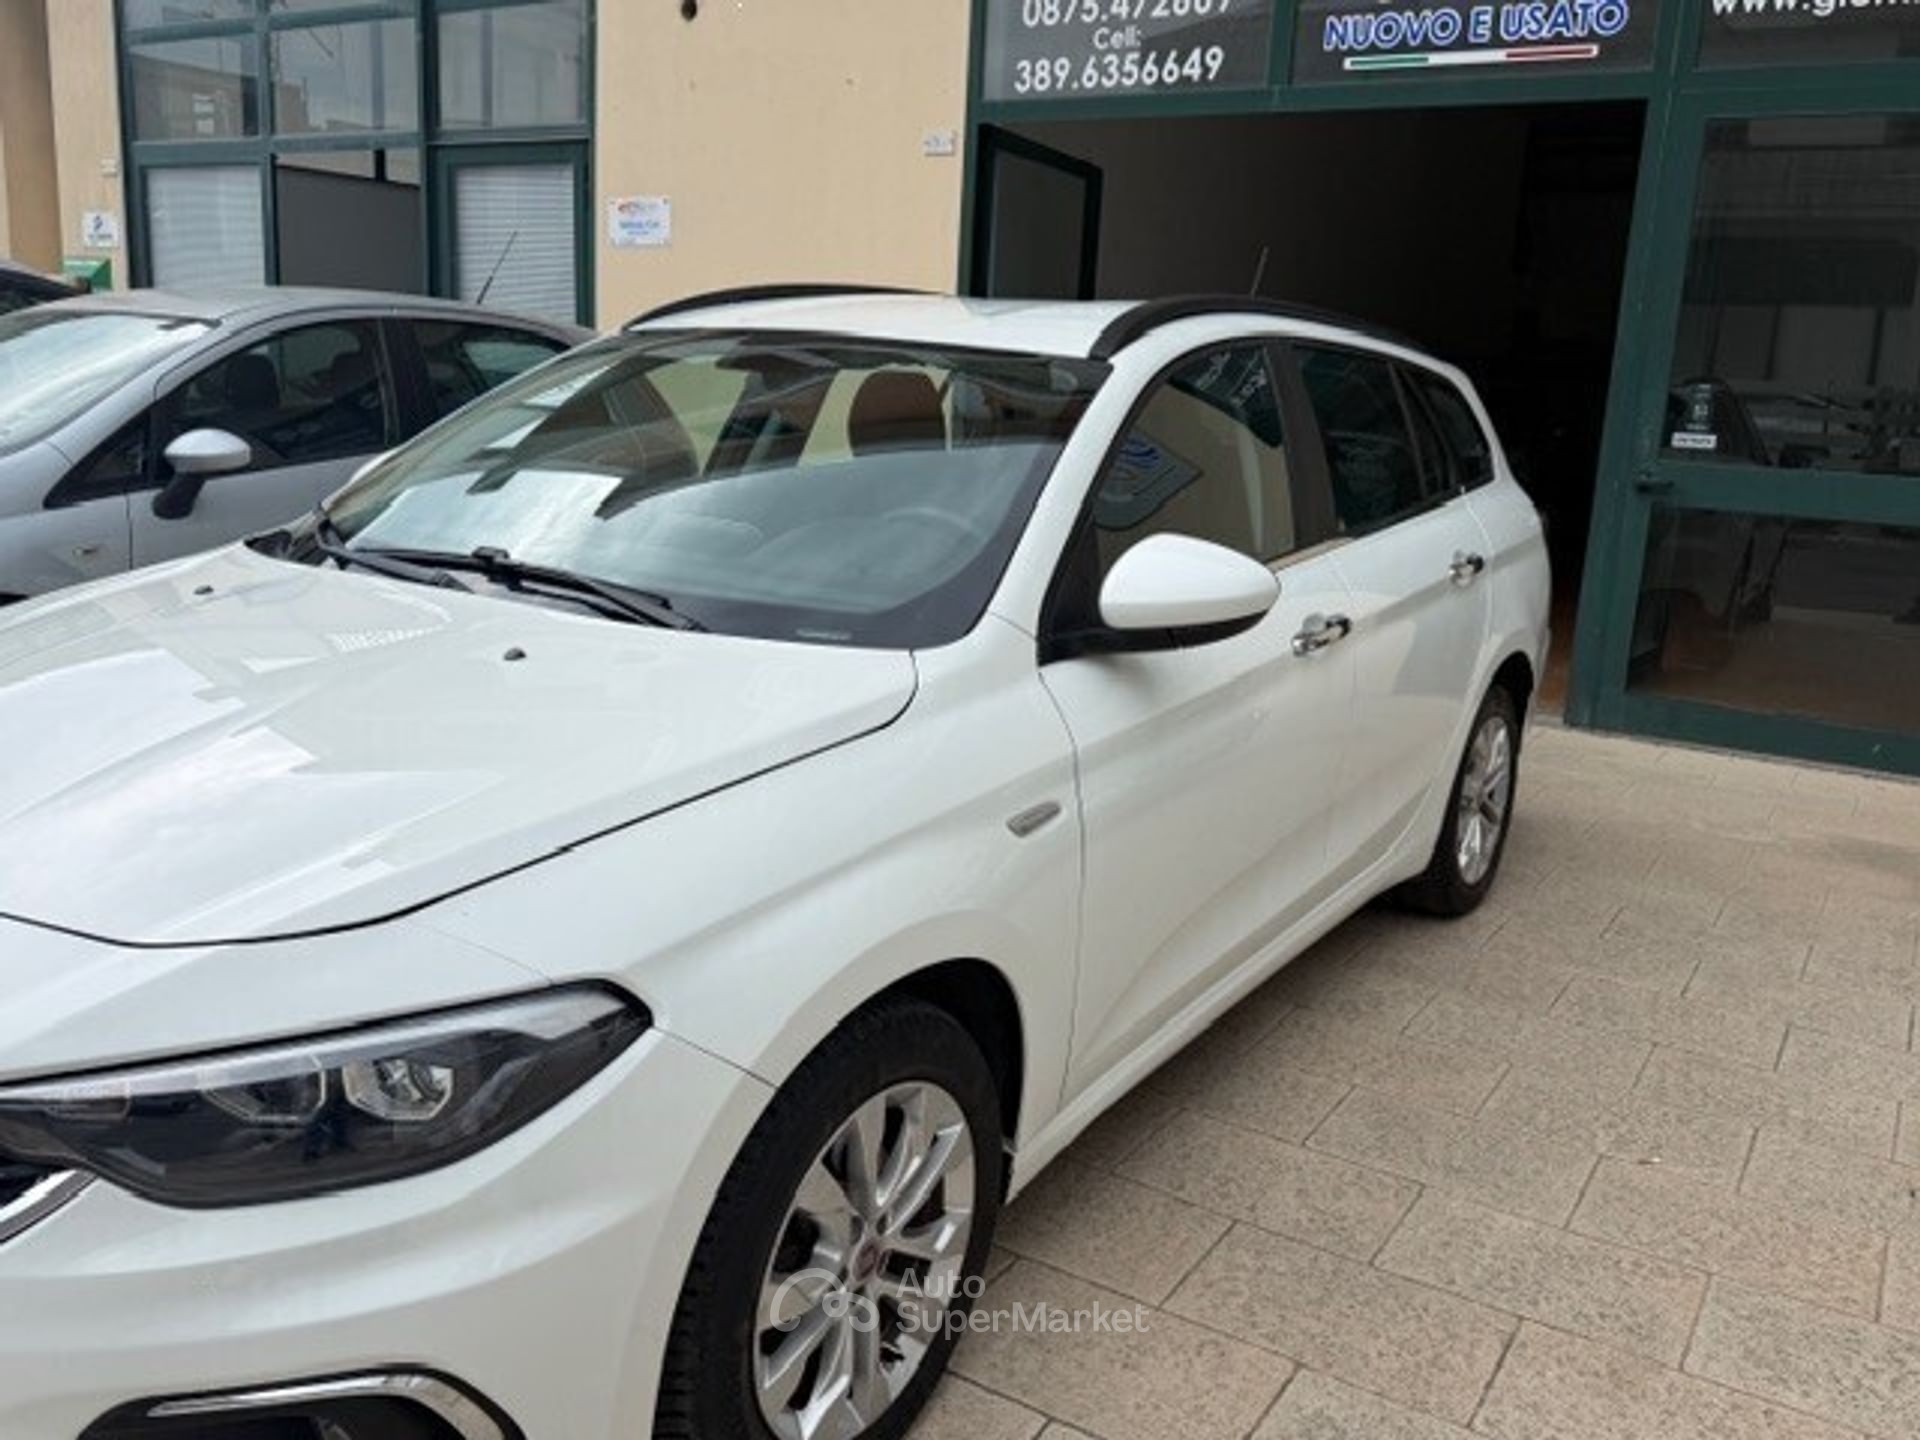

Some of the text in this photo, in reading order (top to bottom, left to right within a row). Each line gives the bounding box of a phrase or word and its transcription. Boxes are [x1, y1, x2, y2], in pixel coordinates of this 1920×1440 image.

[1093, 25, 1142, 50] Cell:
[1323, 0, 1628, 51] NUOVO E USATO
[1013, 45, 1225, 94] 389.6356649
